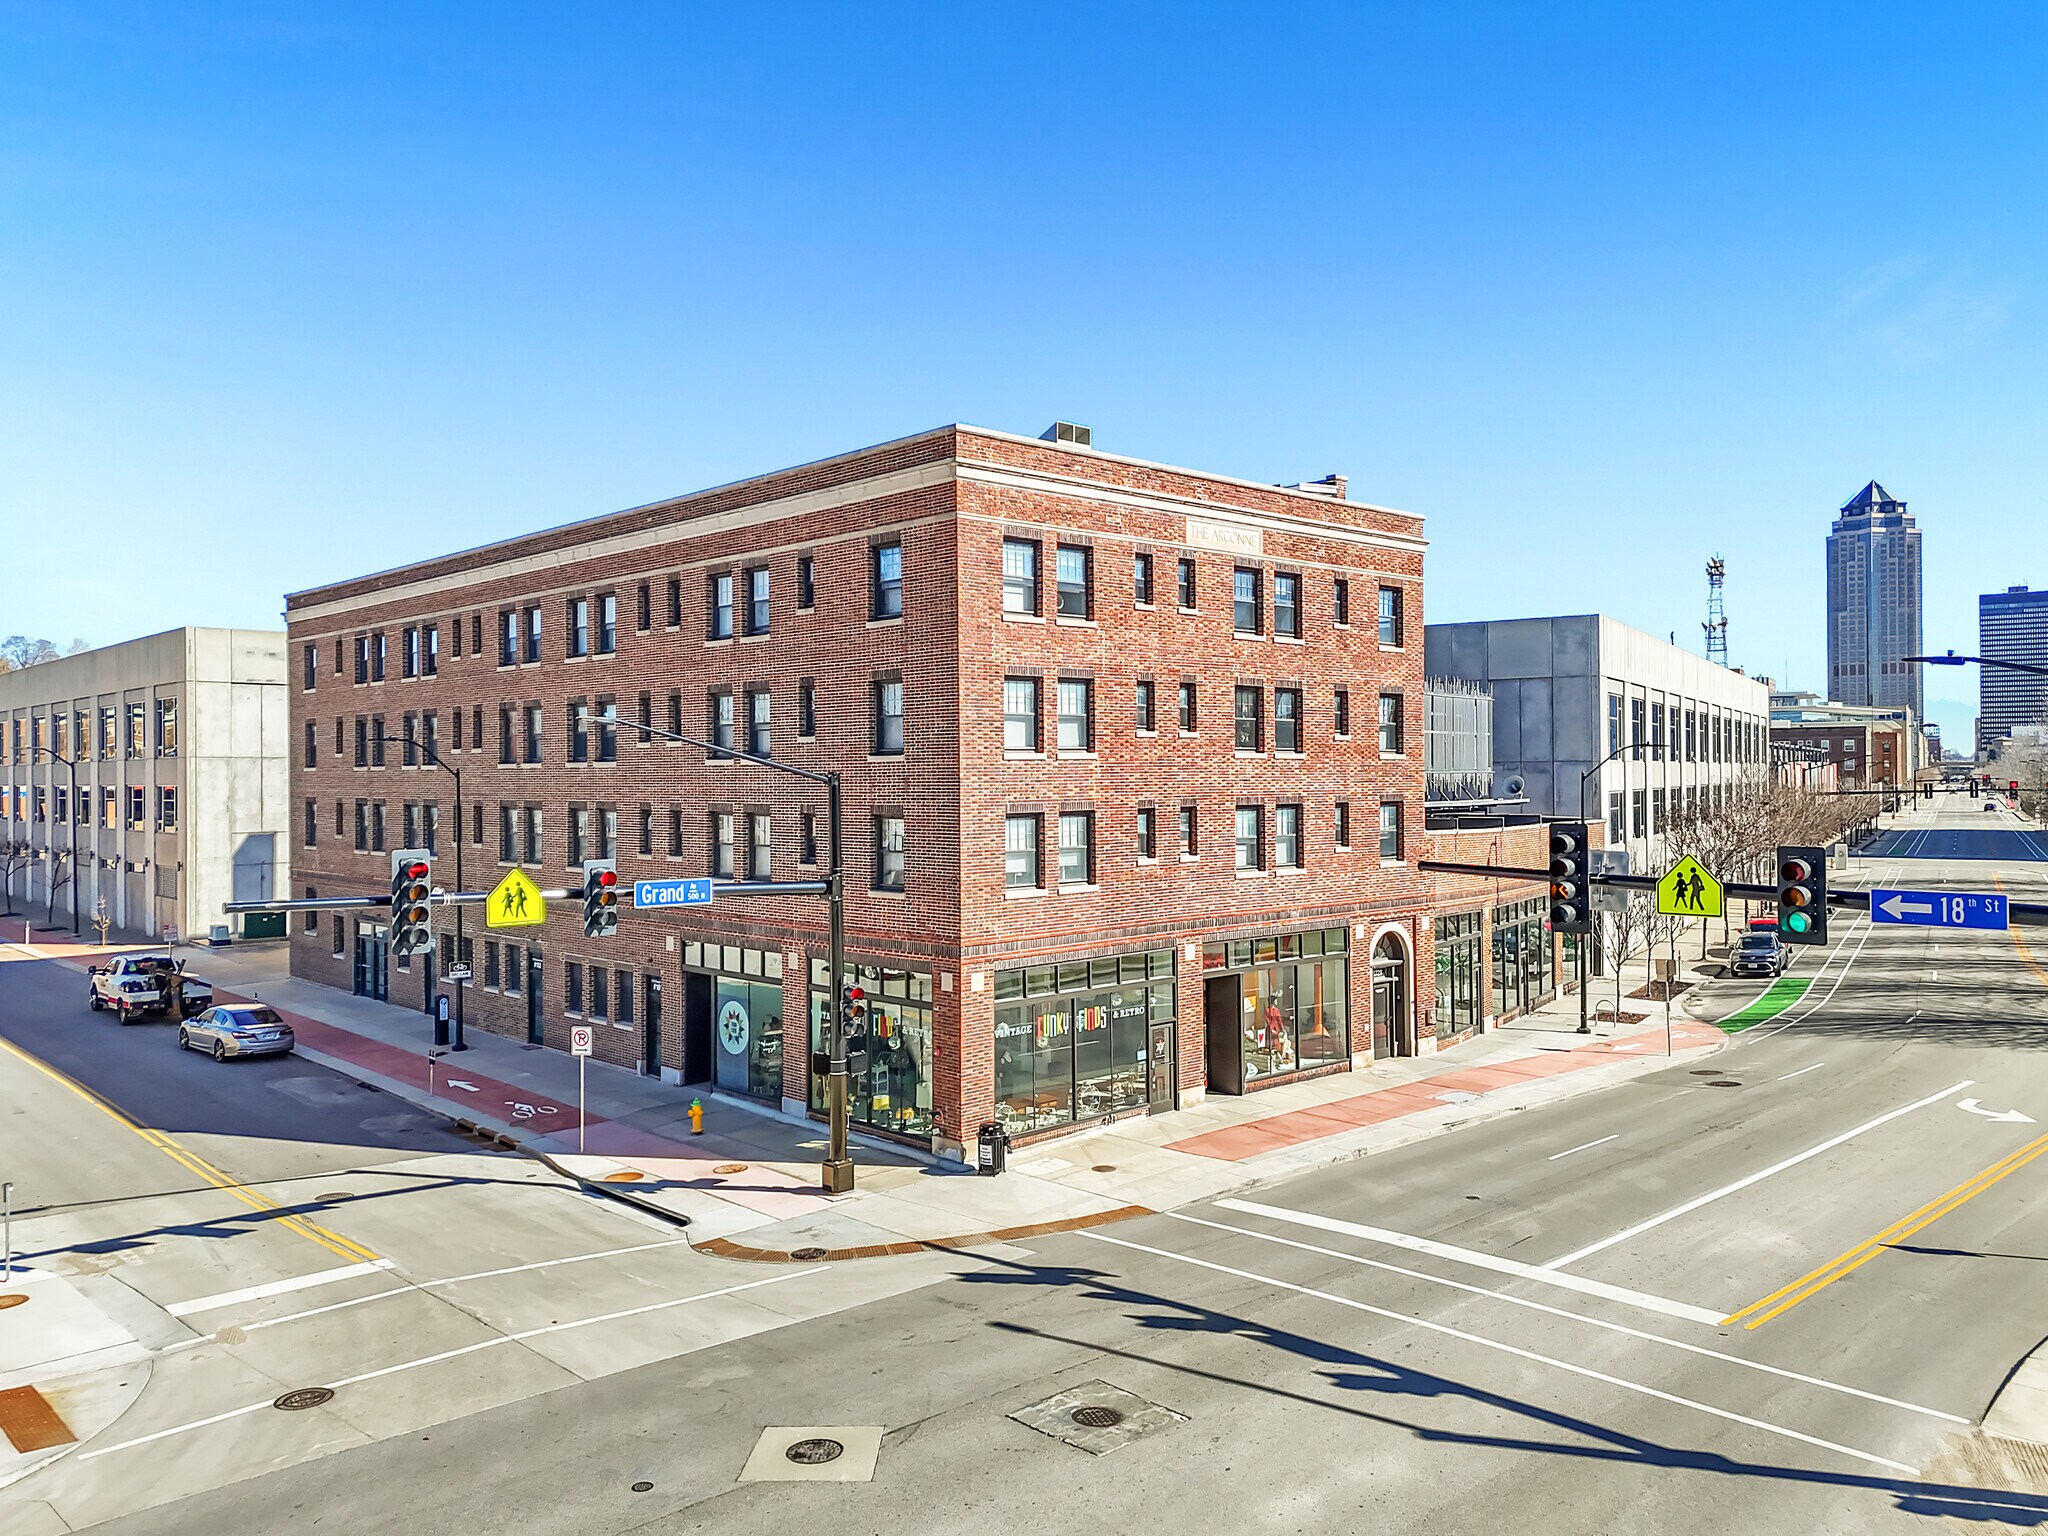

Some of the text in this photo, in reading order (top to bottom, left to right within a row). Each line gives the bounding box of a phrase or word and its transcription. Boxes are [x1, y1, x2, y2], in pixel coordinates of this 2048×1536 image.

[1190, 525, 1209, 540] THE
[641, 883, 685, 904] Grand
[1984, 898, 2000, 913] St
[994, 1005, 1146, 1041] VINTAGE FUNKY FINDS & RETRO
